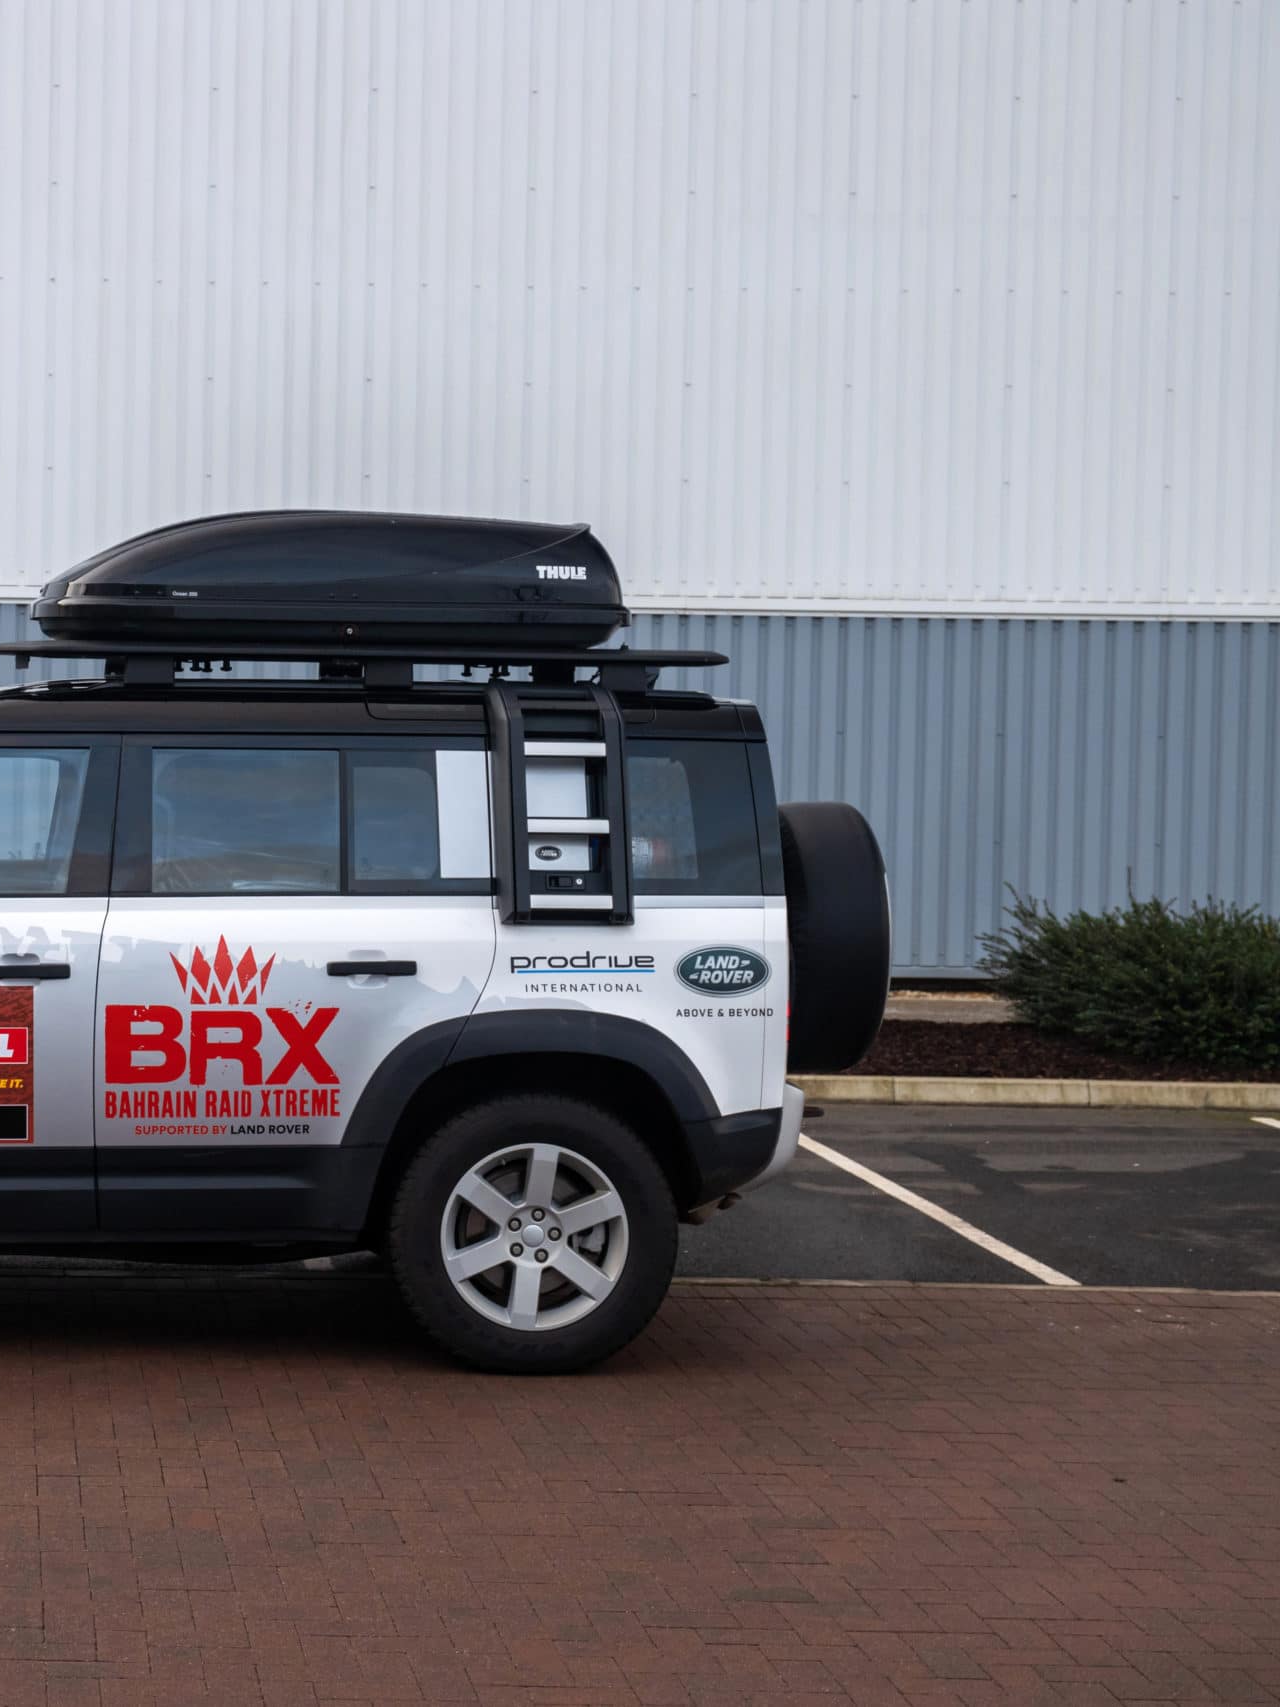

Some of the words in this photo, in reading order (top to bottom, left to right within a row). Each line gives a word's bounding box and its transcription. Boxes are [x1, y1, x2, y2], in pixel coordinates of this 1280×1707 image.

[535, 565, 587, 580] THULE
[695, 955, 740, 970] LAND
[700, 970, 754, 985] ROVER
[524, 983, 643, 993] INTERNATIONAL
[676, 1009, 714, 1017] ABOVE
[717, 1009, 724, 1017] &
[728, 1008, 774, 1017] BEYOND
[105, 1005, 341, 1086] BRX
[9, 1079, 24, 1088] IT.
[105, 1091, 197, 1119] BAHRAIN
[205, 1091, 252, 1118] RAID
[260, 1089, 341, 1118] XTREME
[135, 1125, 209, 1135] SUPPORTED
[212, 1125, 227, 1135] BY
[230, 1125, 266, 1135] LAND
[269, 1124, 310, 1135] ROVER
